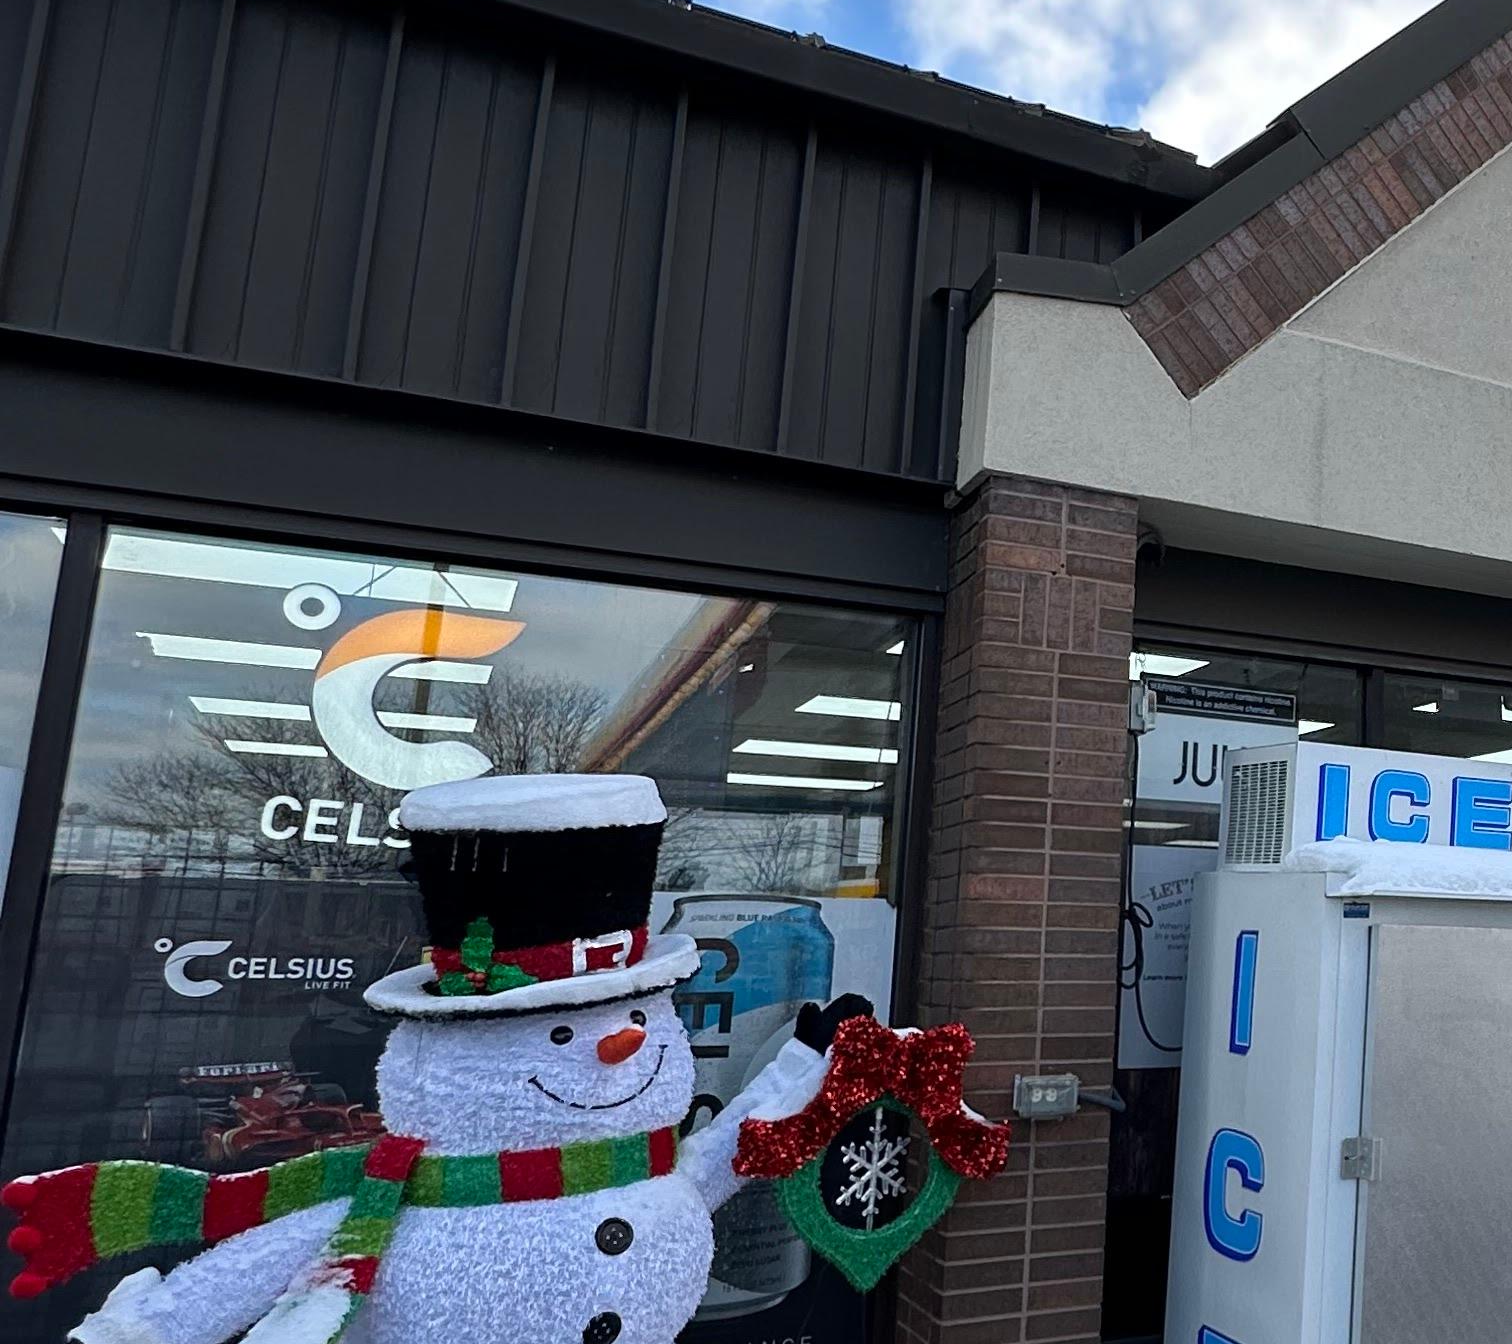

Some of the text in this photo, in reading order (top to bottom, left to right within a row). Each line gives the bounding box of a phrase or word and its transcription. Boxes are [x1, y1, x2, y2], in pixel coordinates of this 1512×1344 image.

[1173, 741, 1228, 787] JU
[1148, 878, 1194, 901] LET'
[227, 957, 354, 979] CELSIUS
[304, 981, 351, 990] LIVE FIT
